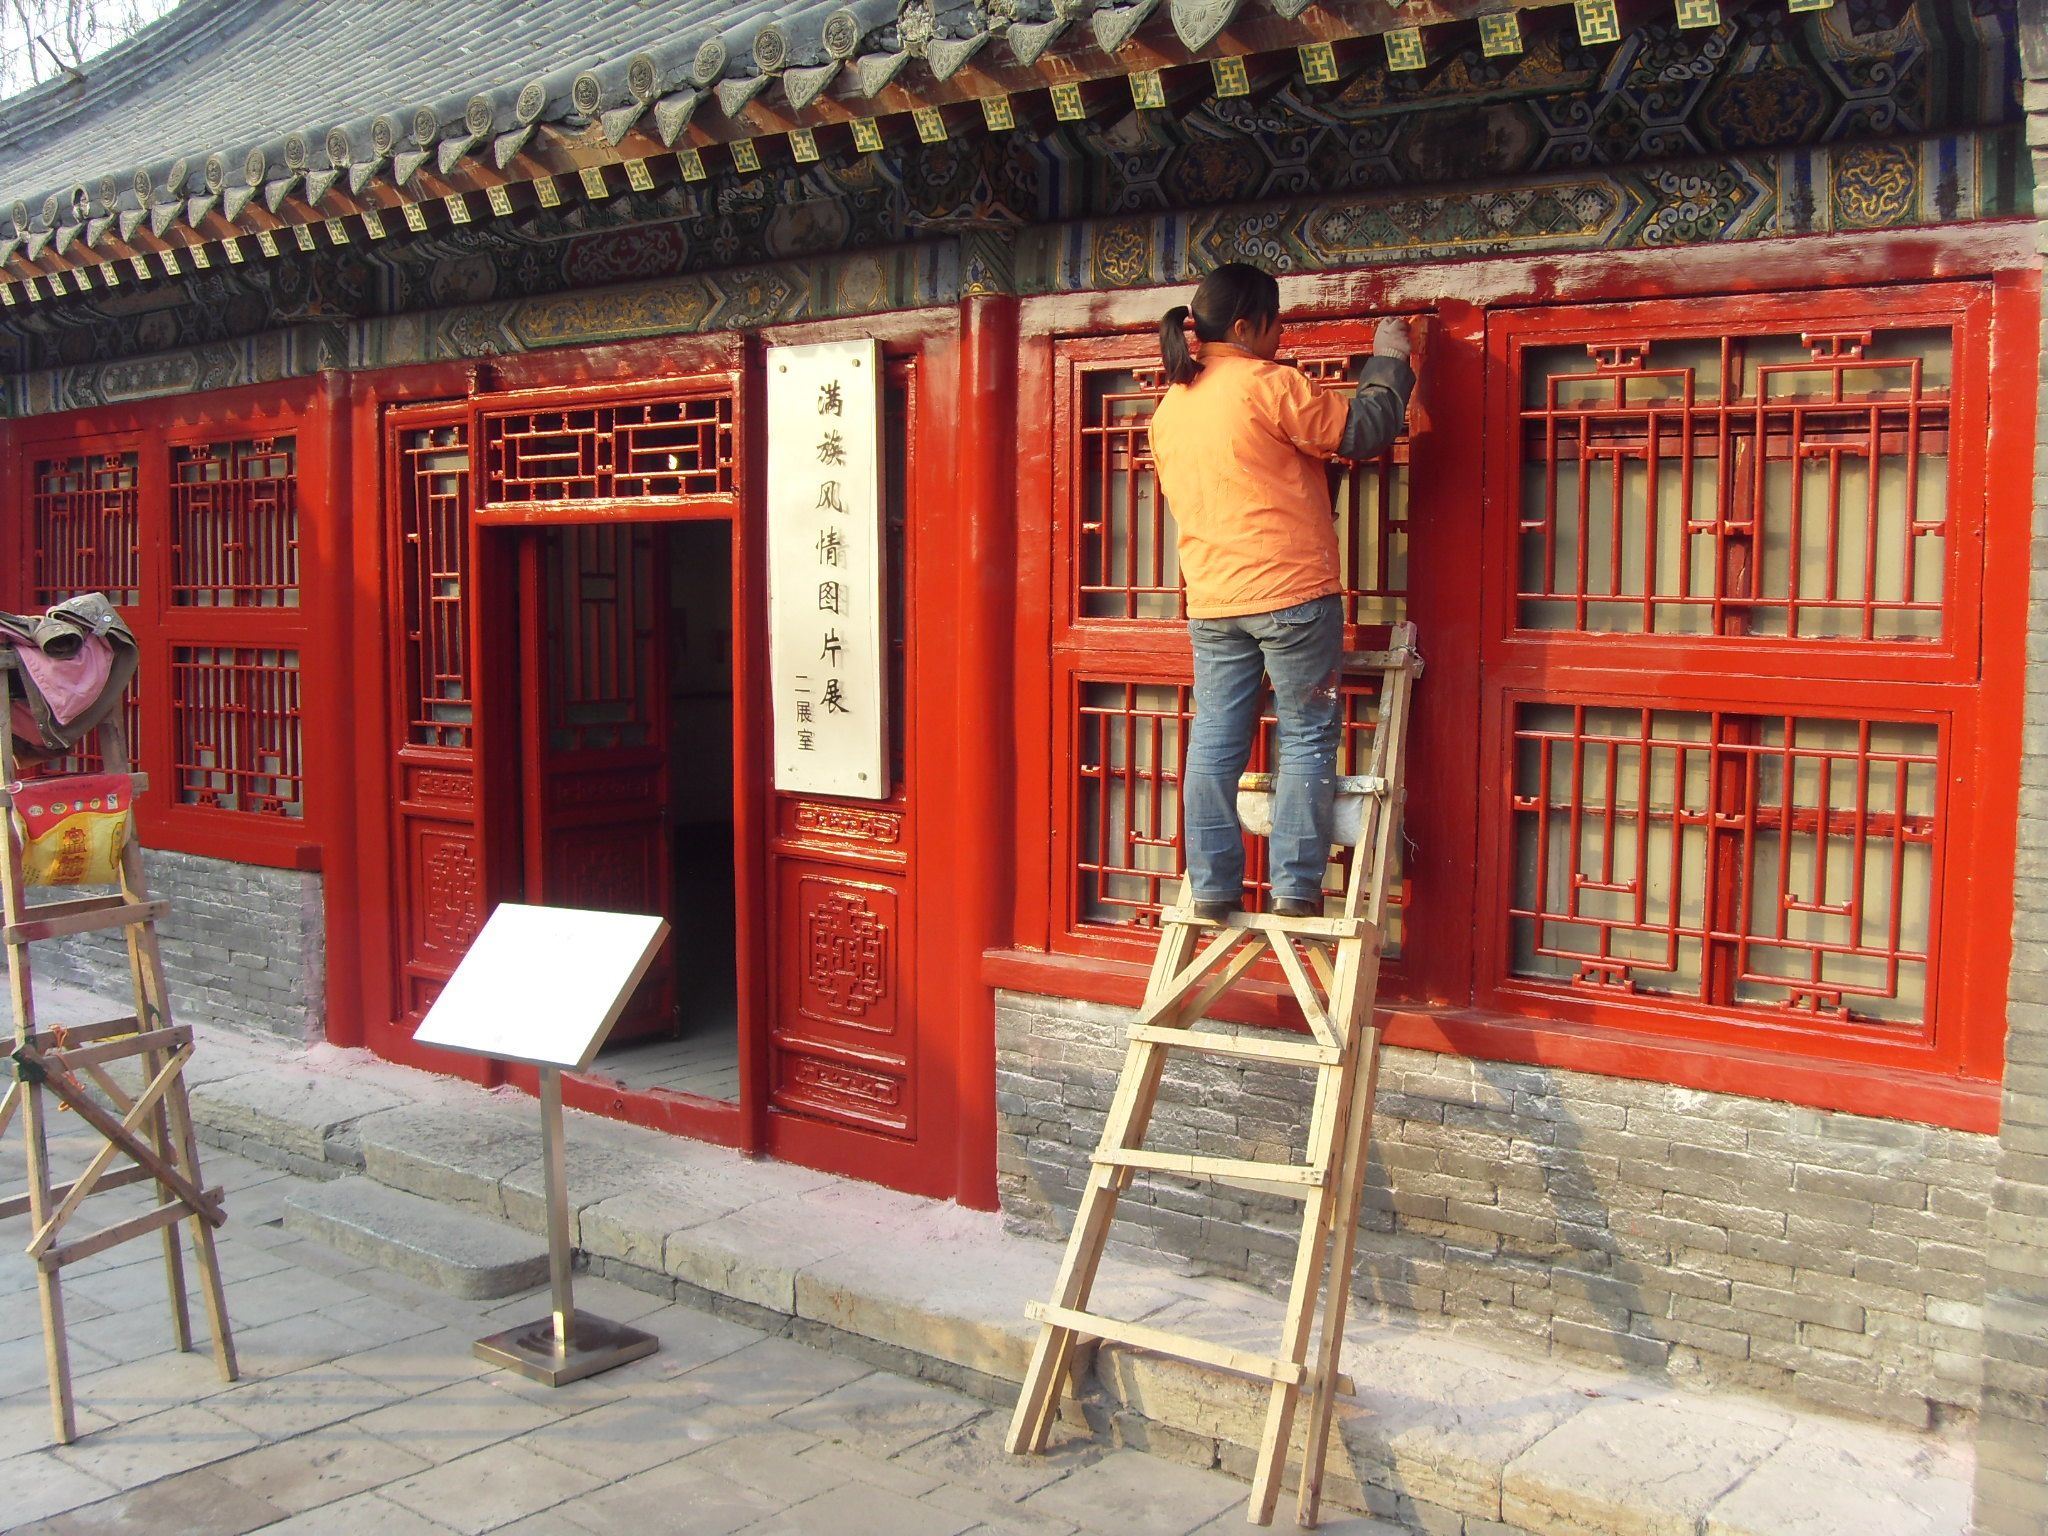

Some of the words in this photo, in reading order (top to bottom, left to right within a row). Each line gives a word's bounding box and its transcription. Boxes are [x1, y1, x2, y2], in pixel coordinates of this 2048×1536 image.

[816, 380, 849, 714] 满族风情图片展
[795, 675, 815, 751] 二展室
